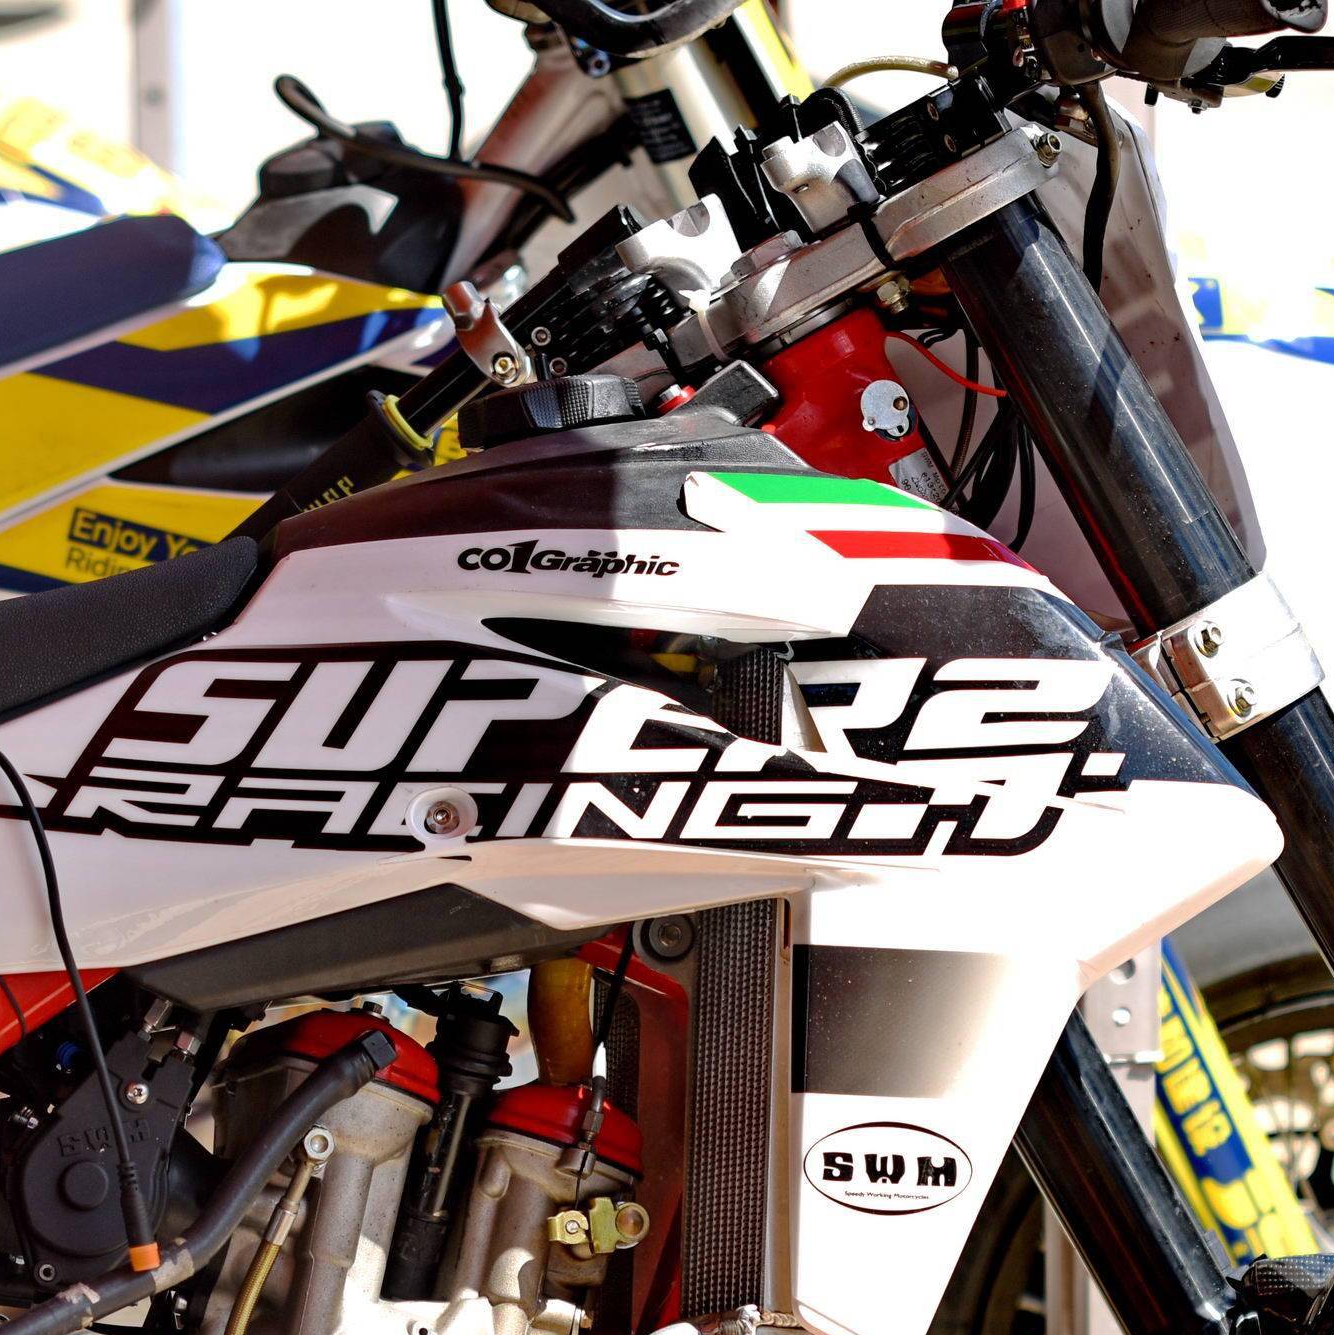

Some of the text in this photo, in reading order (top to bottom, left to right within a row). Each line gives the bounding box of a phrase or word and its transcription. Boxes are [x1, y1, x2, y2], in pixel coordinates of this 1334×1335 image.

[73, 511, 157, 559] Enjoy
[822, 1152, 958, 1187] SWM
[845, 1190, 865, 1198] Speedy
[867, 1191, 892, 1199] Working
